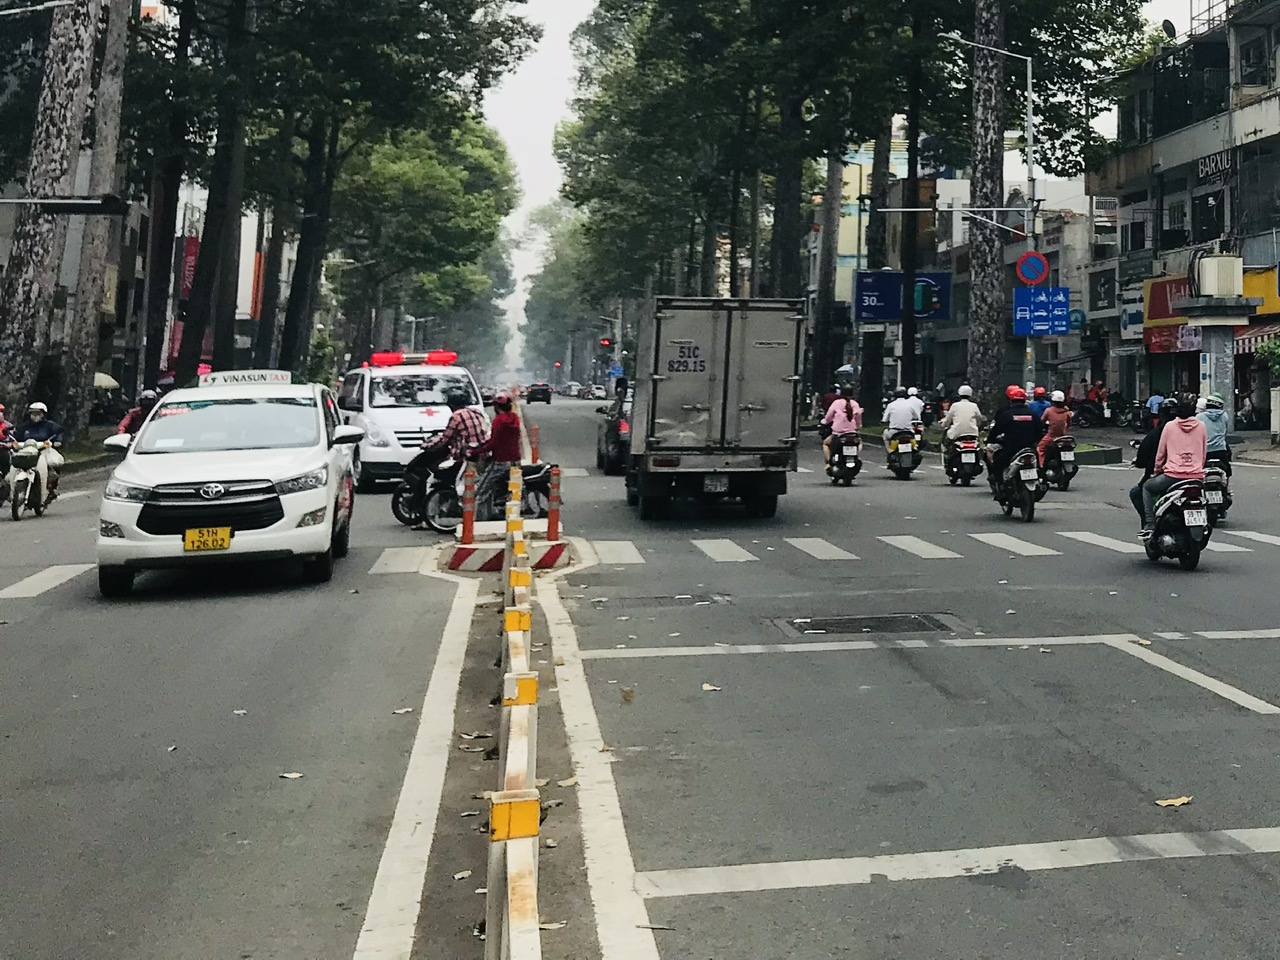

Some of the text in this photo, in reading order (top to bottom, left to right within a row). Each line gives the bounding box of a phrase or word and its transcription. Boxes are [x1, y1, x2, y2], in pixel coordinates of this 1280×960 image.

[678, 346, 700, 359] 51C
[667, 360, 706, 373] 829.15
[222, 373, 289, 384] VINASUN TAXI
